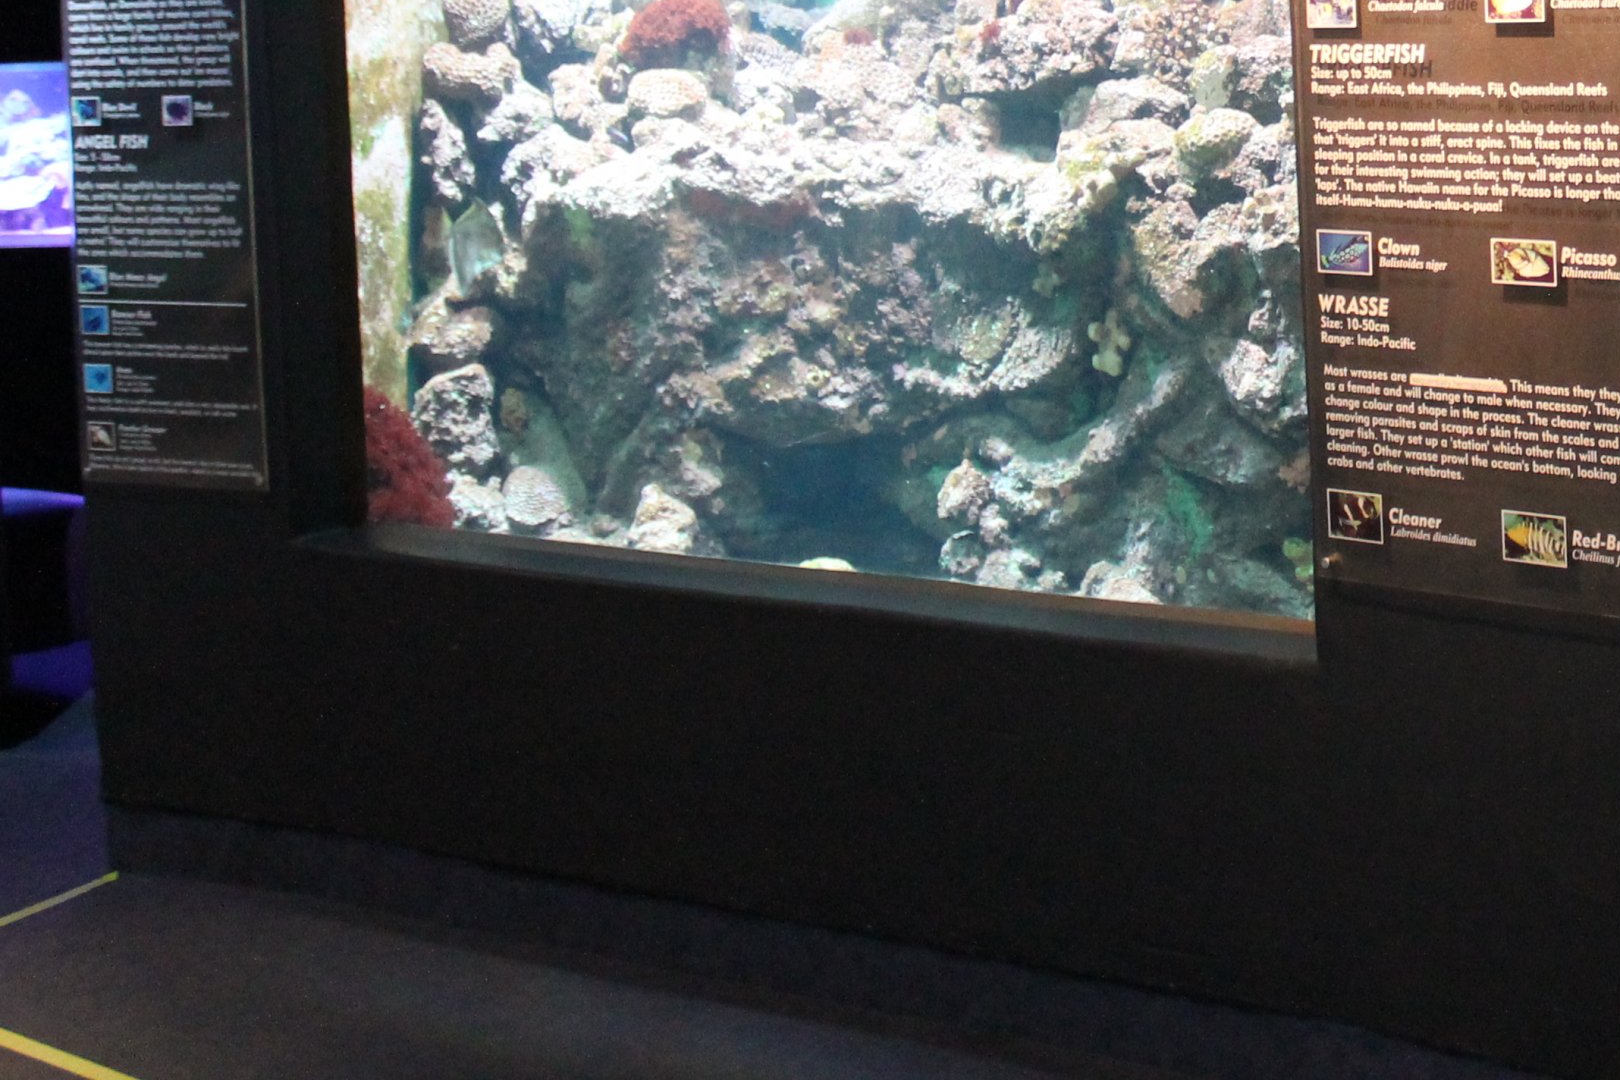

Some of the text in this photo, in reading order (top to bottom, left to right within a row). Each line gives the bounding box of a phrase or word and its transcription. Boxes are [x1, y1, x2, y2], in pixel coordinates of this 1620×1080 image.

[1310, 44, 1426, 63] TRIGGERFISH
[1311, 67, 1392, 81] Size: up to 50cm
[1311, 81, 1608, 98] Range: East Africa, the Philippines, Fiji, Queensland Reefs
[1313, 117, 1365, 133] Triggerfish
[1367, 122, 1384, 130] are
[1387, 122, 1398, 131] so
[1401, 119, 1435, 131] named
[1438, 119, 1479, 132] because
[1482, 120, 1493, 132] of
[1496, 124, 1503, 132] a
[1506, 120, 1544, 136] locking
[1546, 121, 1581, 133] device
[1584, 125, 1598, 134] on
[1601, 122, 1619, 134] the
[75, 135, 149, 149] ANGEL FISH
[1316, 194, 1503, 214] itself-Humu-humu-nuku-nuku-a-puaa!
[1378, 238, 1420, 256] Clown
[1561, 247, 1617, 266] Picasso
[1379, 257, 1448, 273] Balistoides niger
[1318, 294, 1389, 316] WRASSE
[1321, 316, 1389, 332] Size: 10-50cm
[1321, 331, 1416, 350] Range: Indo-Pacific
[1324, 364, 1347, 377] Most
[1351, 370, 1388, 380] wrasses
[1391, 373, 1406, 382] are
[1510, 380, 1532, 392] This
[1535, 386, 1569, 396] means
[1573, 386, 1595, 401] they
[1325, 383, 1335, 391] as
[1339, 384, 1344, 392] a
[1347, 382, 1381, 395] female
[1384, 386, 1401, 397] and
[1405, 387, 1421, 399] will
[1424, 389, 1460, 405] change
[1463, 392, 1474, 403] to
[1477, 395, 1502, 406] male
[1506, 397, 1532, 409] when
[1536, 402, 1591, 417] necessary.
[1595, 404, 1620, 420] They
[1325, 395, 1360, 411] change
[1363, 399, 1393, 411] colour
[1396, 402, 1415, 413] and
[1418, 404, 1447, 419] shape
[1450, 406, 1460, 418] in
[1463, 408, 1479, 419] the
[1482, 413, 1524, 424] process.
[1527, 414, 1548, 426] The
[1551, 417, 1590, 430] cleaner
[1327, 424, 1354, 439] larger
[1357, 427, 1377, 439] fish.
[1381, 429, 1404, 445] They
[1408, 433, 1422, 444] set
[1426, 437, 1438, 449] up
[1450, 436, 1490, 451] 'station'
[1493, 442, 1522, 454] which
[1526, 445, 1553, 458] other
[1556, 448, 1576, 460] fish
[1579, 450, 1597, 462] will
[1327, 440, 1370, 457] cleaning.
[1373, 444, 1401, 458] Other
[1405, 451, 1438, 461] wrasse
[1441, 454, 1468, 466] prowl
[1472, 455, 1488, 467] the
[1491, 460, 1529, 471] ocean's
[1533, 461, 1573, 479] bottom,
[1577, 466, 1617, 484] looking
[1328, 455, 1464, 480] crabs and other vertebrates.
[1389, 508, 1442, 528] Cleaner
[1391, 527, 1477, 546] Labroides dimidiatus
[1572, 549, 1614, 564] Cheilinus
